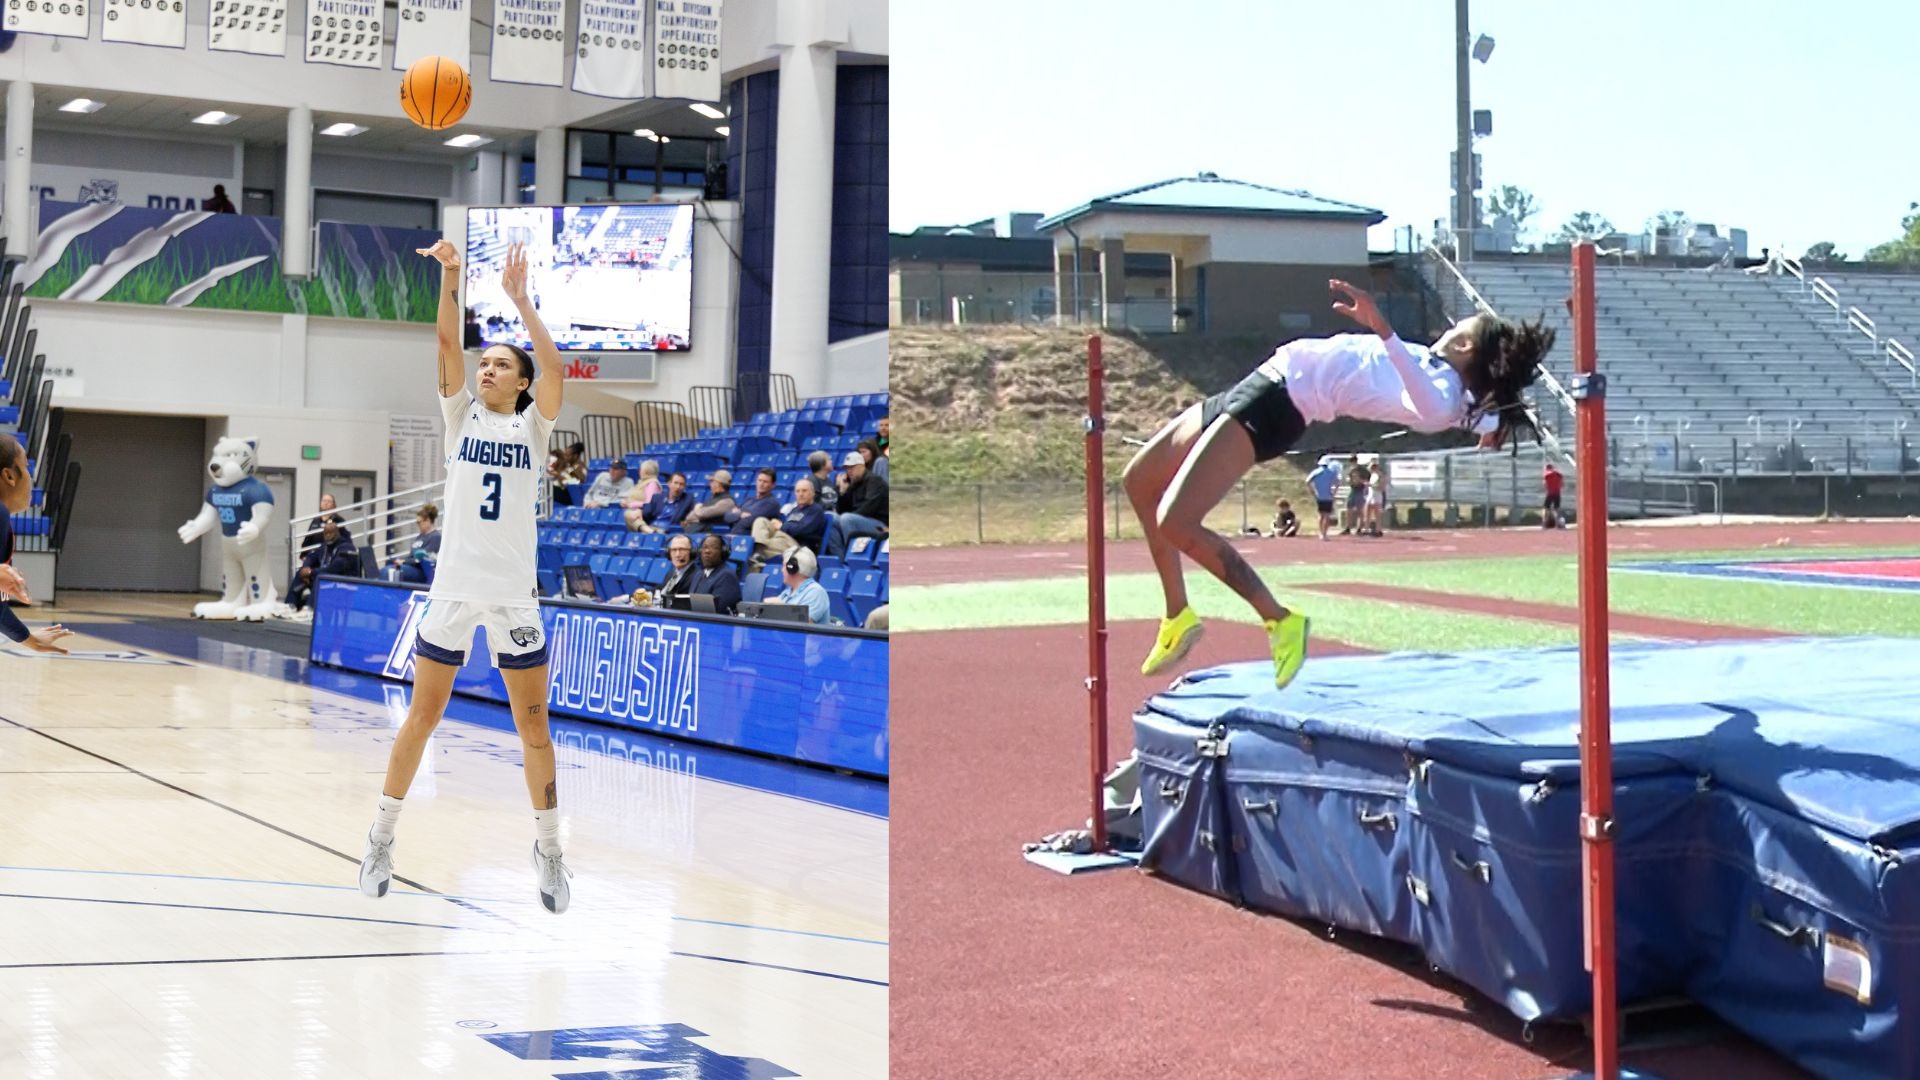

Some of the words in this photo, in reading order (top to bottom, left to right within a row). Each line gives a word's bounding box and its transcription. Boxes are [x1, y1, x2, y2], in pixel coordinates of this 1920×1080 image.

[318, 0, 375, 16] PARTICIPANT
[584, 3, 640, 20] CHAMPIONSHI
[504, 10, 557, 26] PARTICIPANT
[587, 18, 637, 35] PARTICIPAN
[562, 359, 600, 379] oke
[458, 437, 531, 470] AUGUSTA
[480, 472, 502, 521] 3
[547, 613, 700, 731] AUGUSTA
